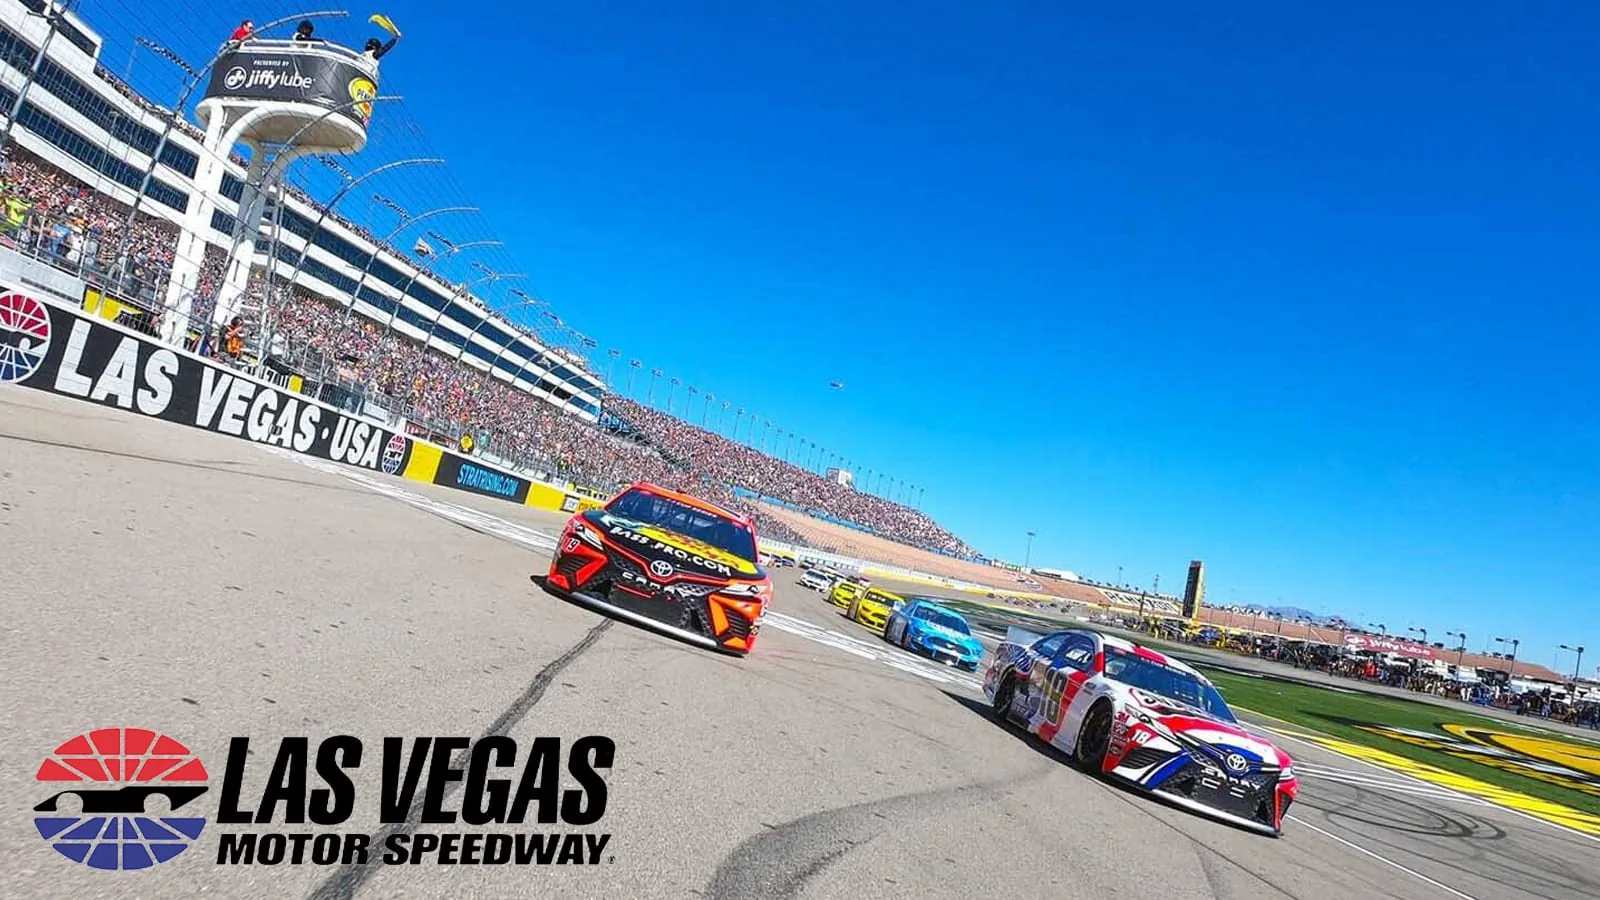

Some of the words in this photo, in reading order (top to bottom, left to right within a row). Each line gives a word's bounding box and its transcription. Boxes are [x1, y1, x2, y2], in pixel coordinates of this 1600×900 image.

[54, 319, 179, 415] LAS
[196, 366, 321, 452] VEGAS
[329, 416, 383, 469] USA
[565, 537, 581, 552] 19
[1132, 729, 1150, 745] 18
